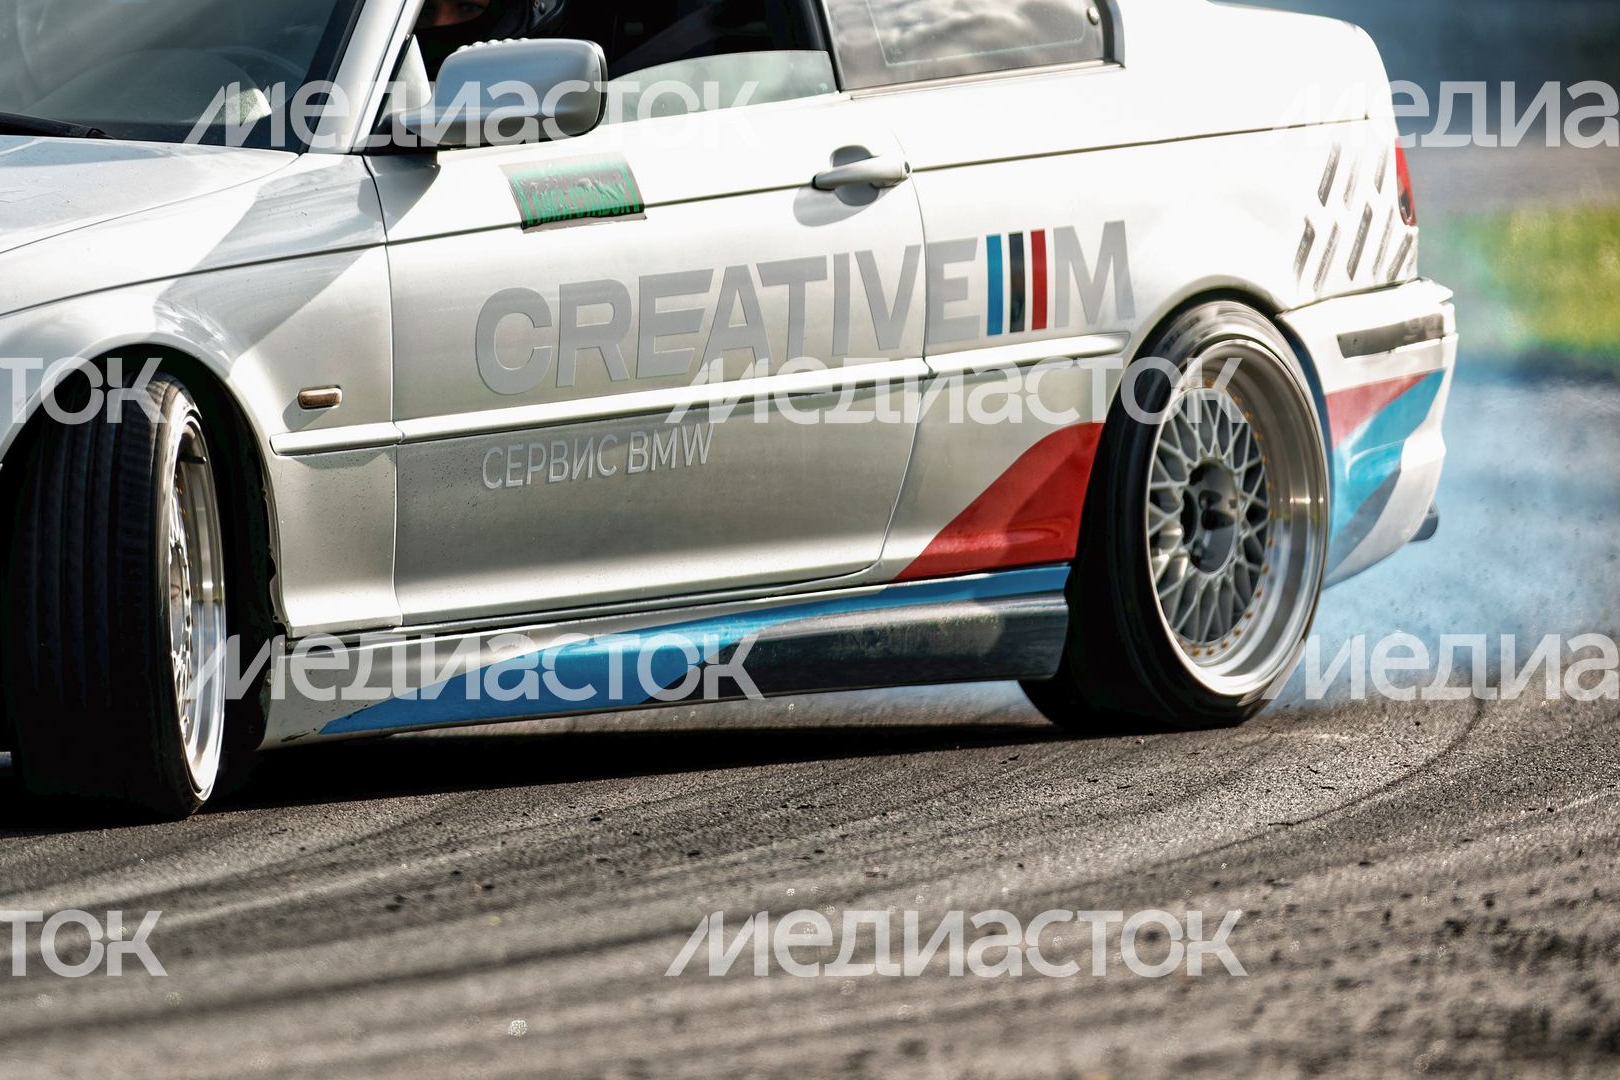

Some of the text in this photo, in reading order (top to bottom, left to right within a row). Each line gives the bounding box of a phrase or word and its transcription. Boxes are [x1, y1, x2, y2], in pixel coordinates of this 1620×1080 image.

[475, 237, 978, 395] CREATIVE
[482, 423, 715, 489] СЕРВИС BMW
